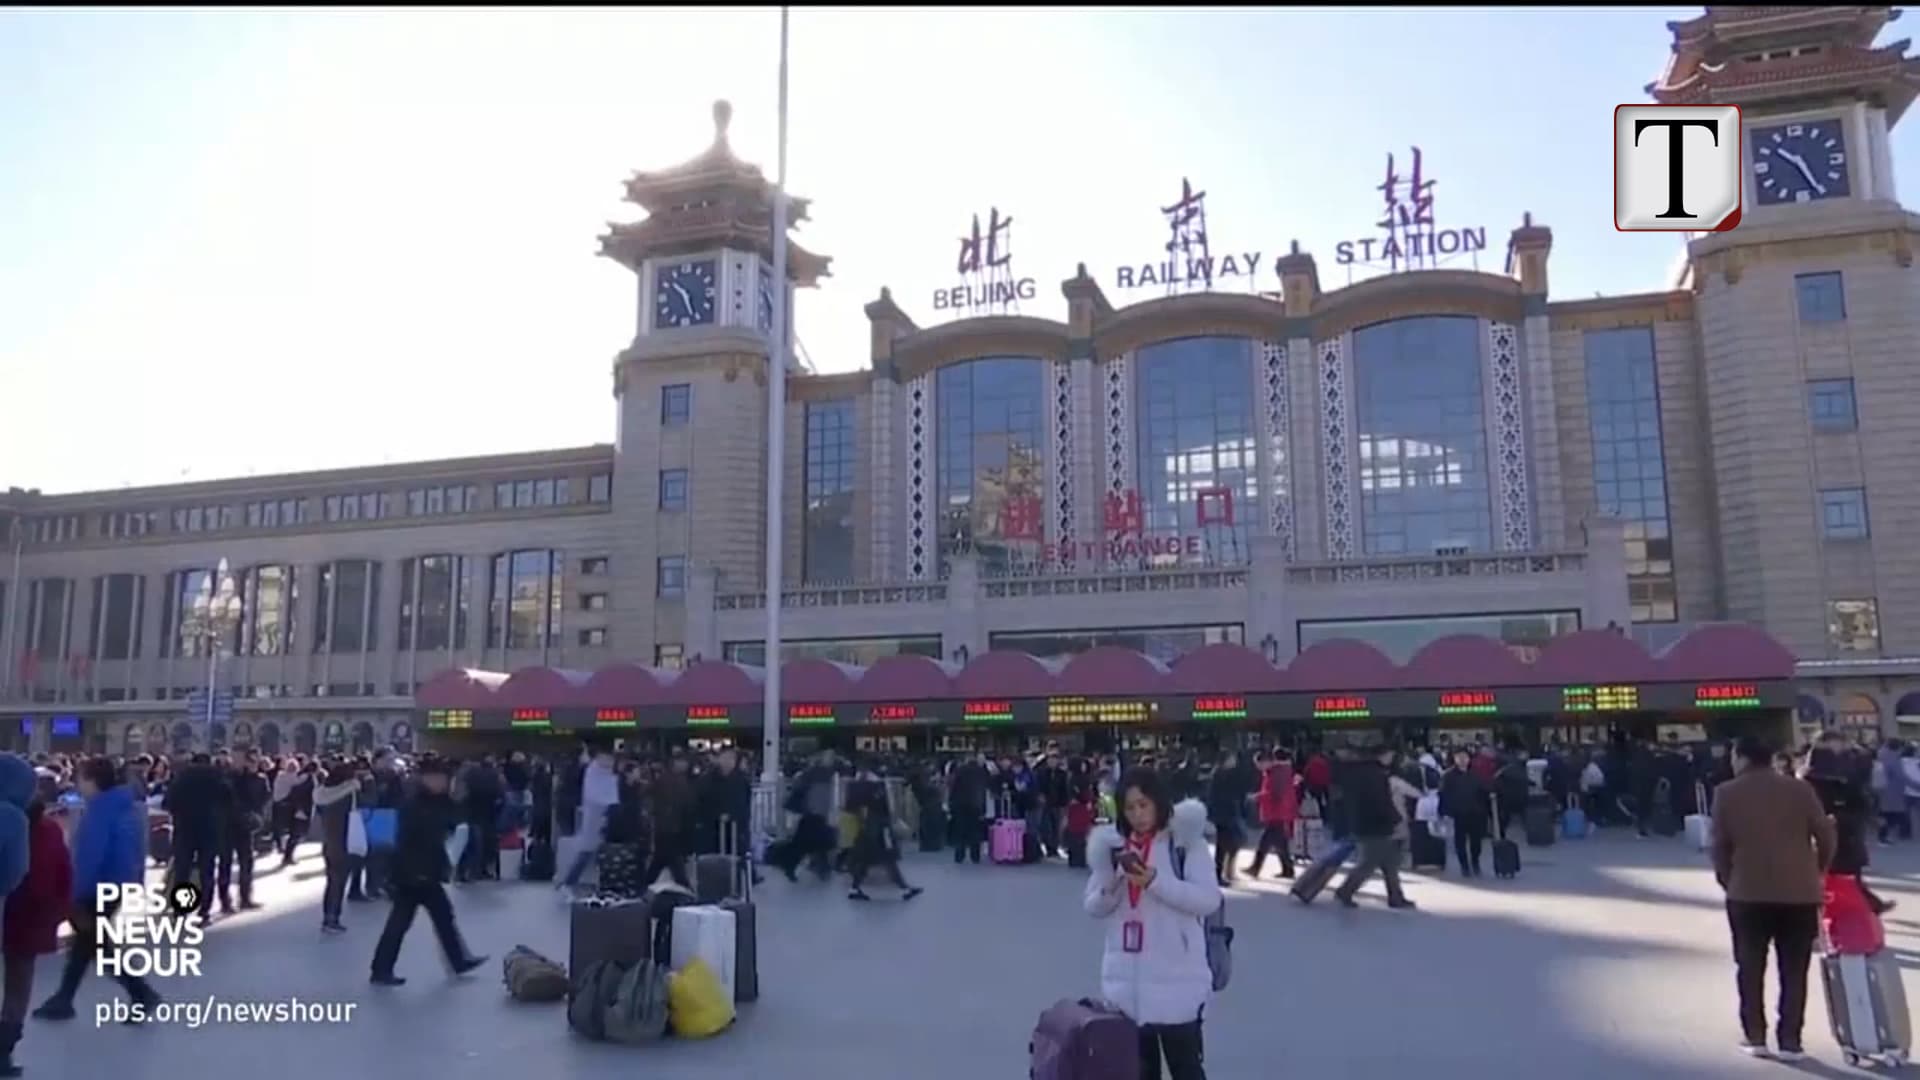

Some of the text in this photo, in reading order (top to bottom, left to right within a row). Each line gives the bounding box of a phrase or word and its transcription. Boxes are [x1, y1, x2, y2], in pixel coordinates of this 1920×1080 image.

[933, 226, 1486, 310] BEIJING RAILWAY STATION
[1042, 535, 1202, 563] ENTRANCE
